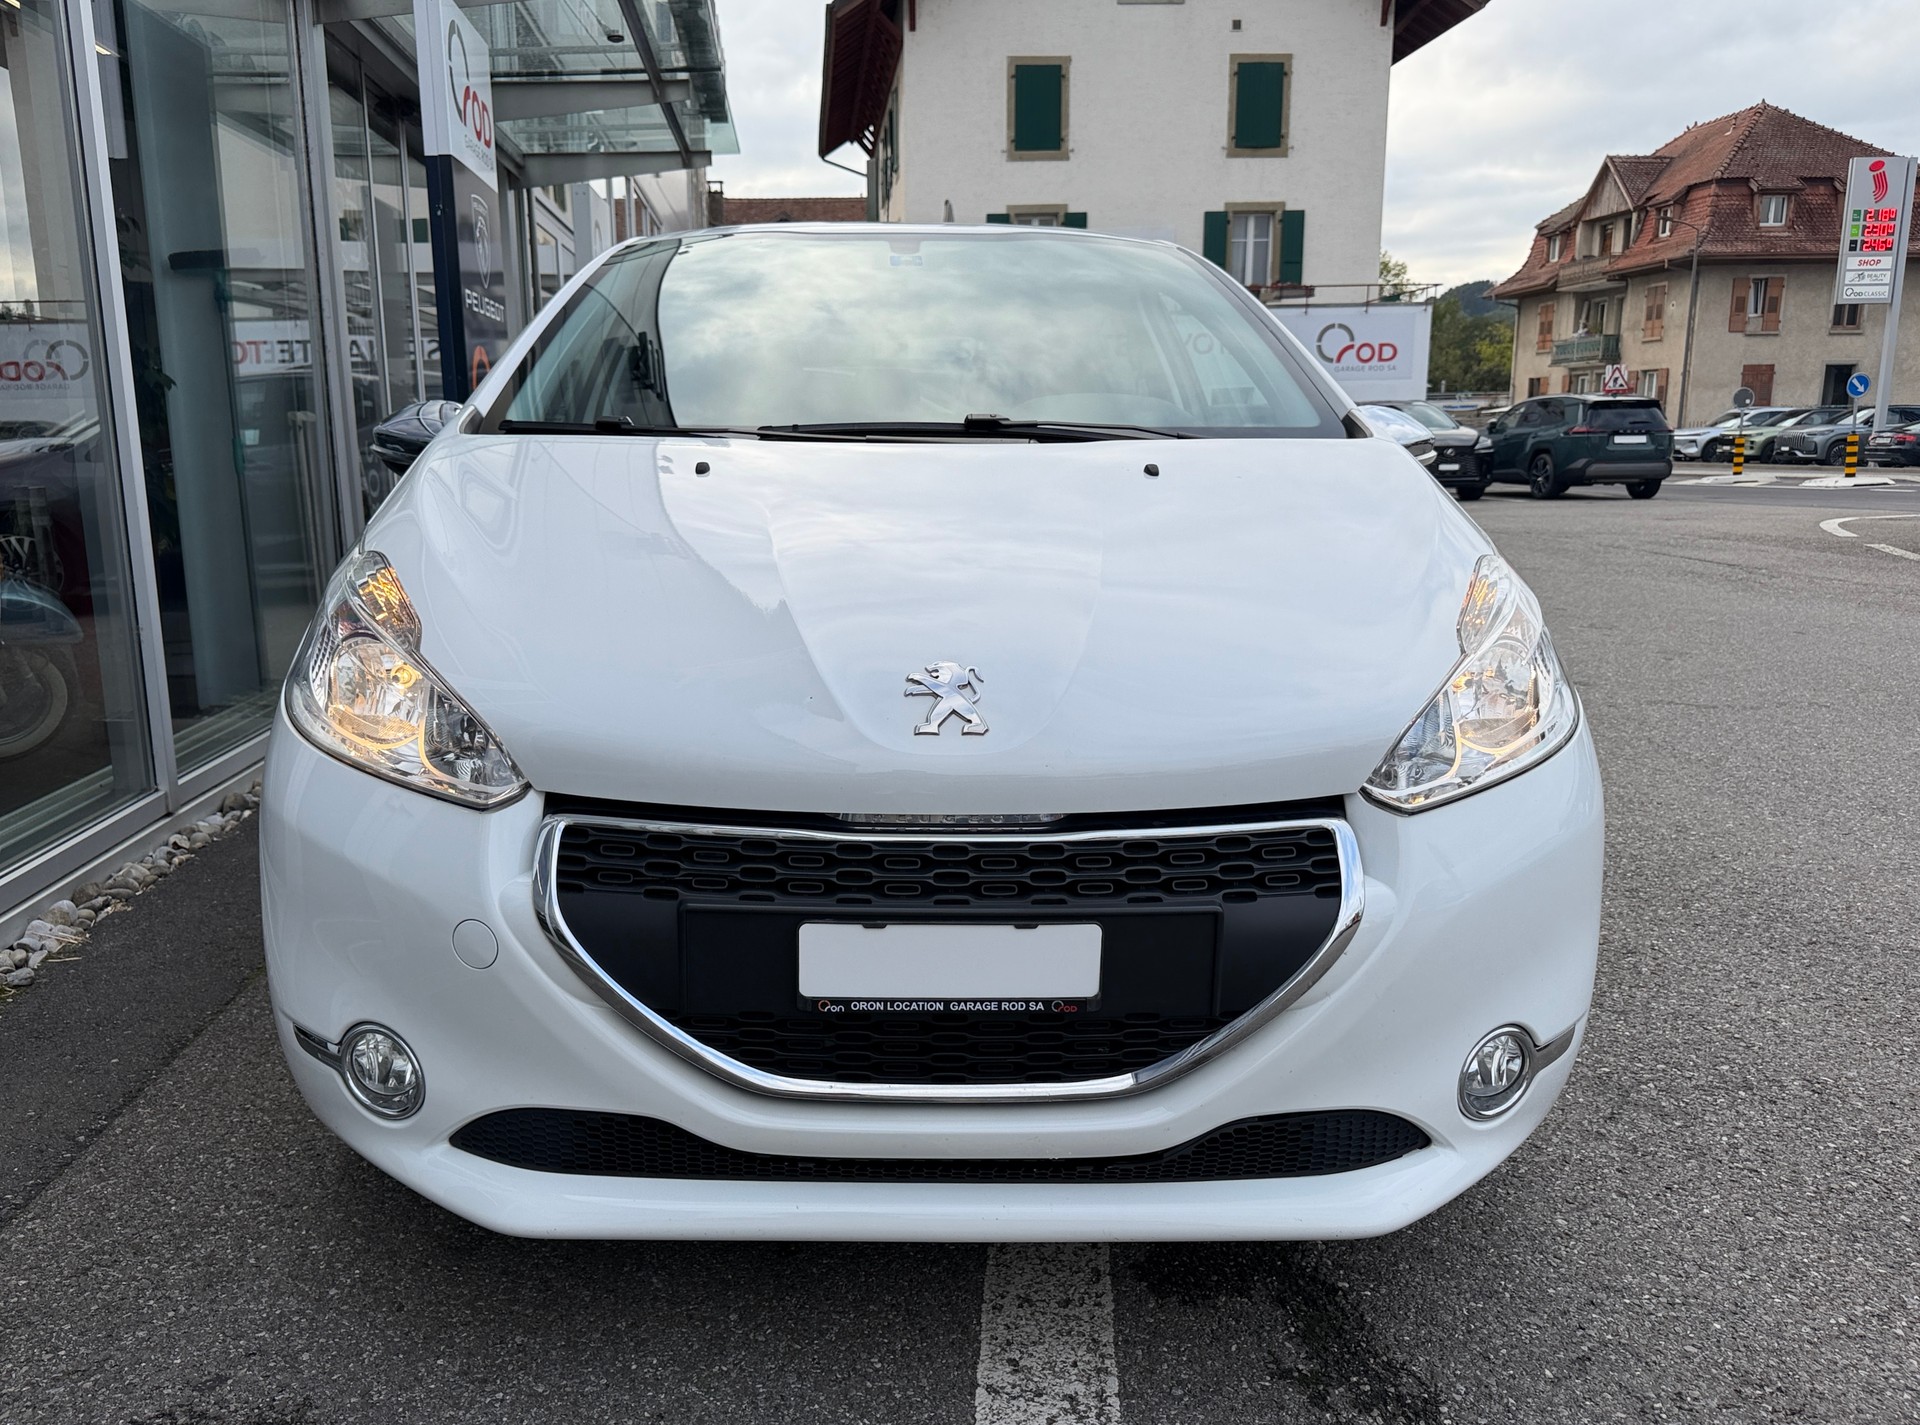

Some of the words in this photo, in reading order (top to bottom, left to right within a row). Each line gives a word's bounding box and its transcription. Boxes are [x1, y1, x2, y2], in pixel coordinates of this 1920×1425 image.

[1857, 259, 1881, 267] SHOP
[464, 289, 505, 323] PEUGEOT
[1334, 365, 1366, 373] GARAGE
[851, 1001, 884, 1011] ORON
[887, 1001, 944, 1011] LOCATION
[949, 1001, 999, 1011] GARAGE
[1001, 1001, 1026, 1011] ROD
[1028, 1001, 1045, 1011] SA
